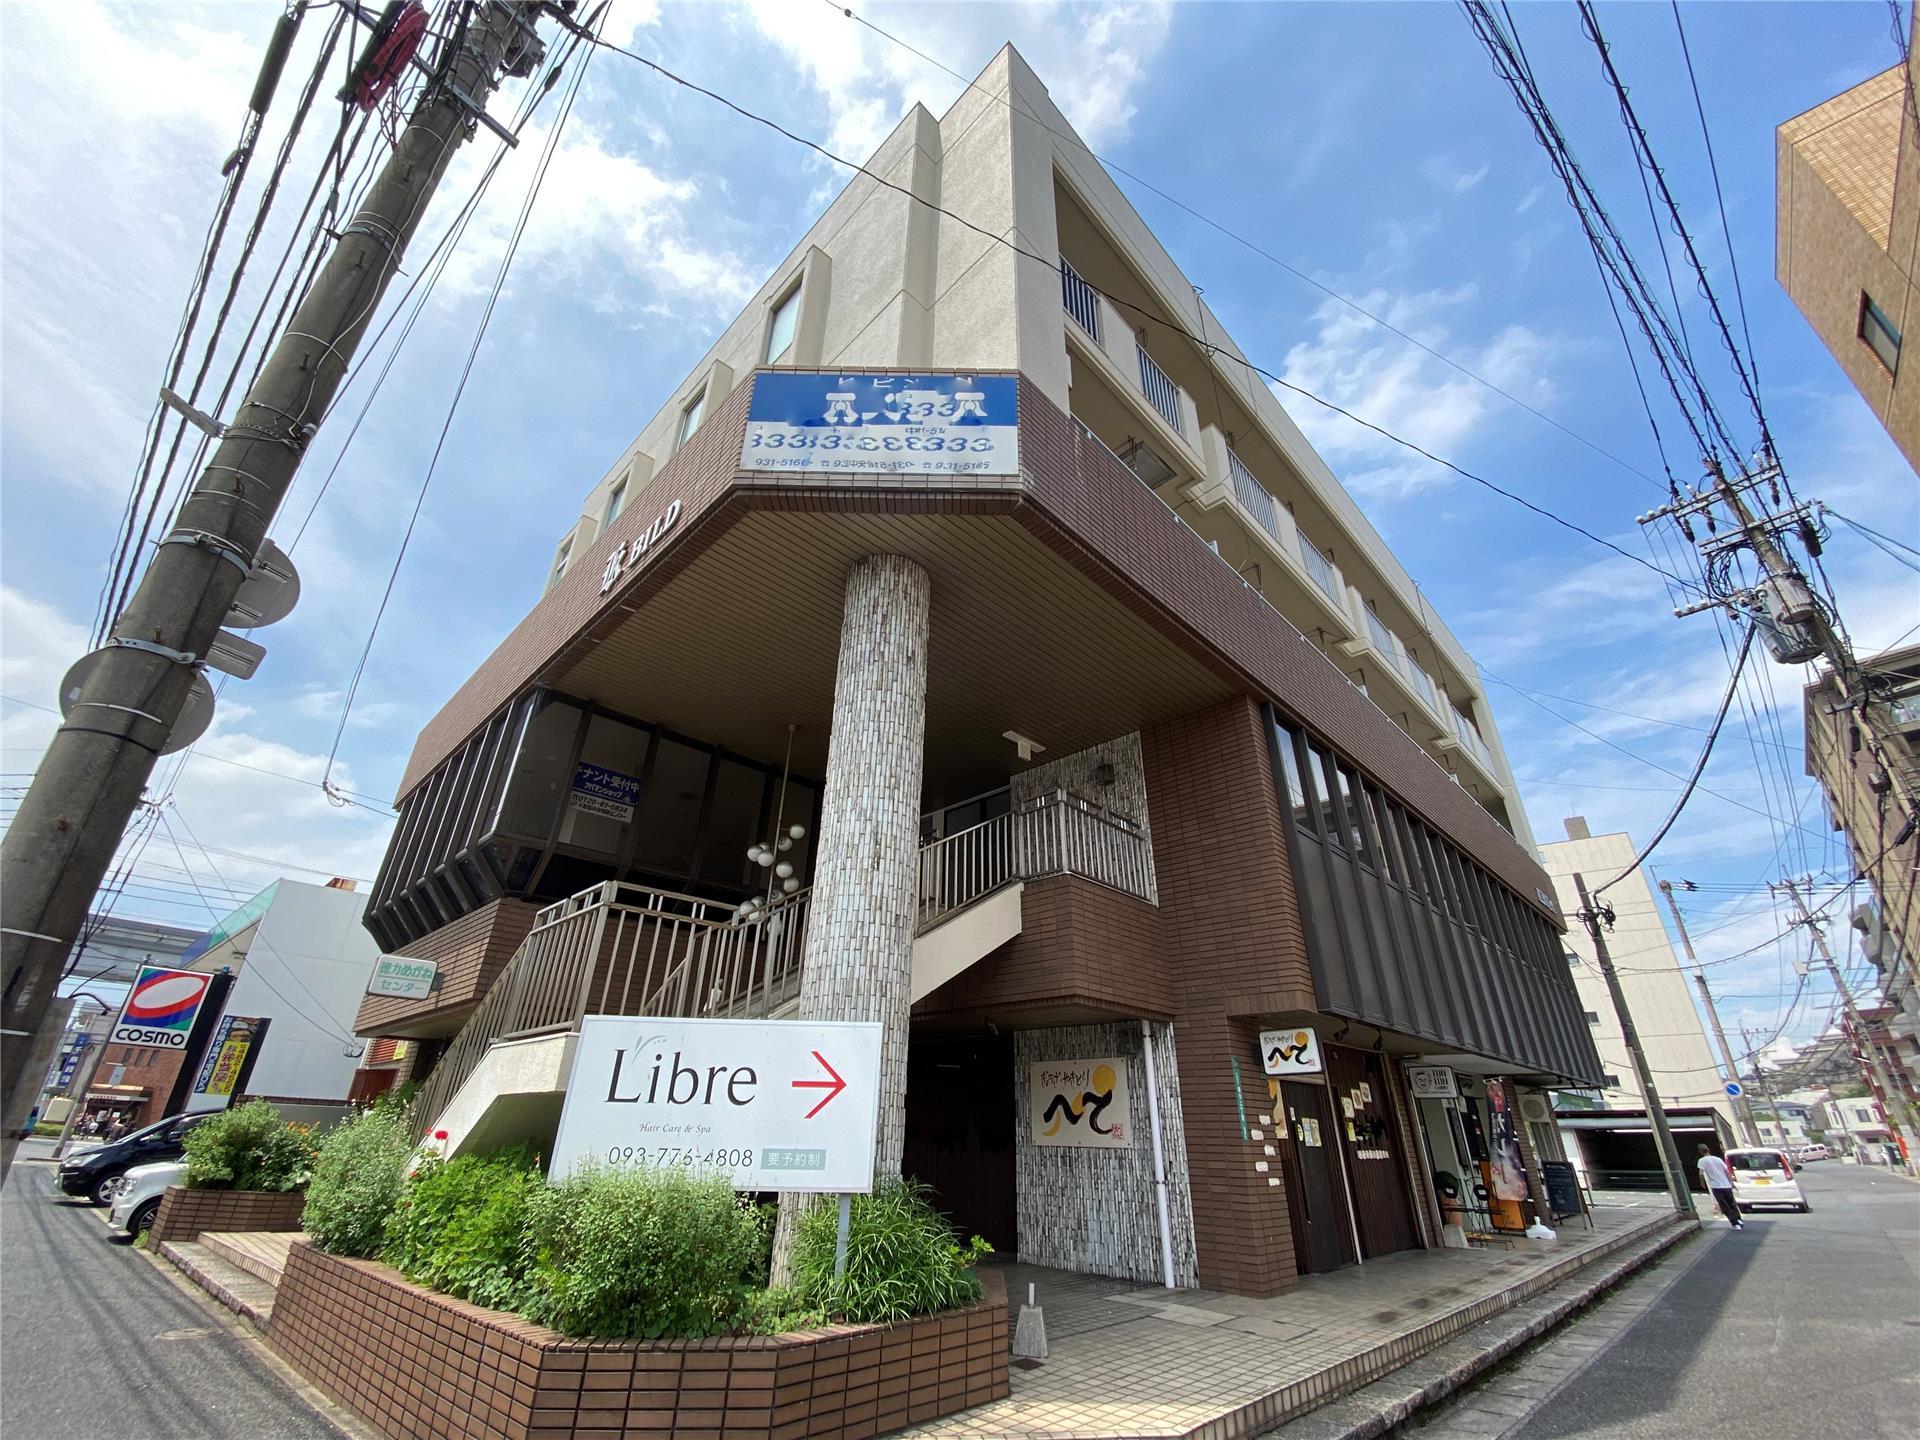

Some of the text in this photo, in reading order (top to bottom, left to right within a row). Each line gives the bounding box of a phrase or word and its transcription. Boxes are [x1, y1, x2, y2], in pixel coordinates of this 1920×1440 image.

[628, 498, 682, 567] BILD
[381, 979, 425, 993] センター
[115, 1027, 186, 1047] COSMO
[604, 1048, 759, 1107] Libre
[639, 1122, 712, 1137] Hair Care & Spa
[607, 1145, 754, 1168] 093-776-4808
[766, 1151, 822, 1168] 要予約制
